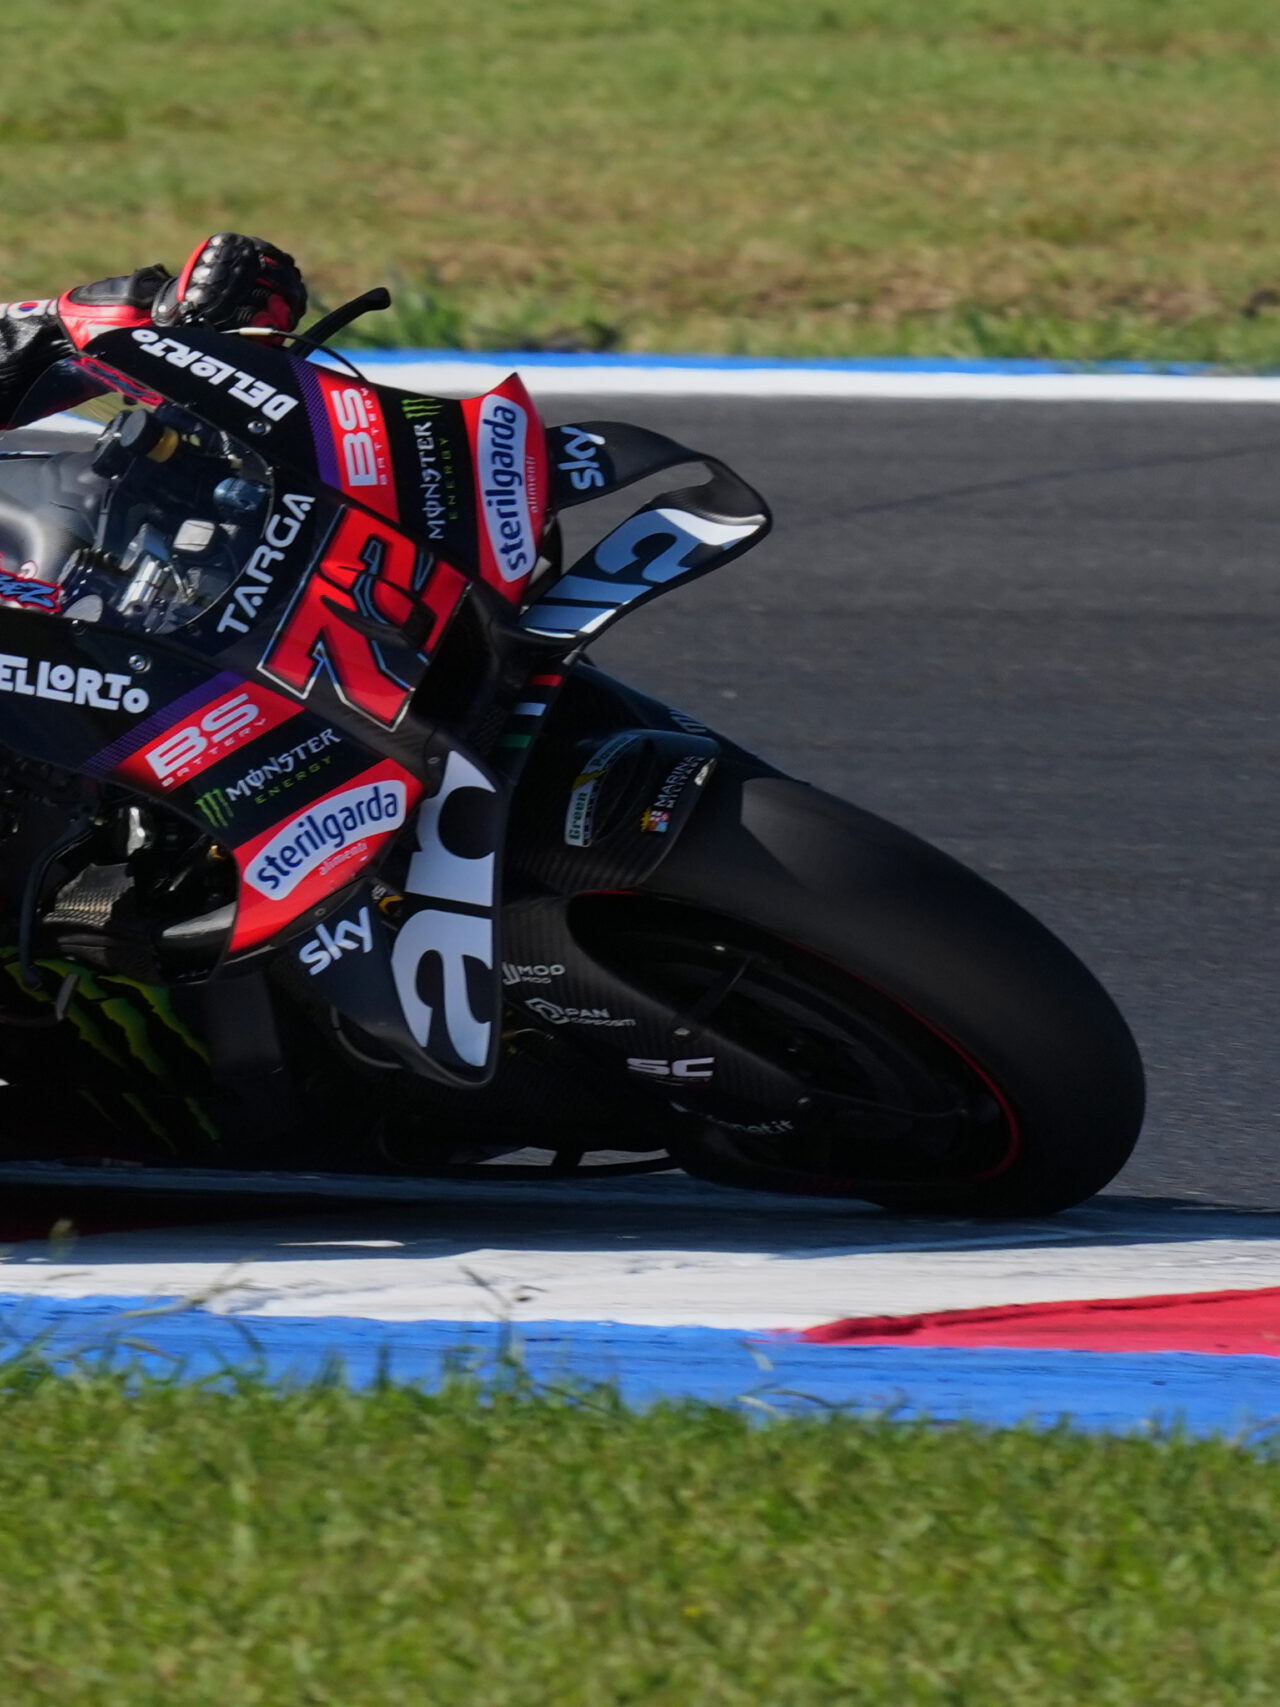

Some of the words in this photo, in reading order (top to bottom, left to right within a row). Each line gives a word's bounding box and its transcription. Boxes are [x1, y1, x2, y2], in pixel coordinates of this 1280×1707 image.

[131, 329, 298, 421] DELLORTO
[330, 388, 378, 487] BS
[413, 421, 446, 540] MONSTER
[439, 437, 458, 521] ENERGY
[558, 426, 606, 490] sky
[482, 405, 528, 572] sterilgarda
[217, 493, 316, 633] TARGA
[144, 692, 260, 780] BS
[224, 728, 341, 801] MONSTER
[254, 755, 332, 805] ENERGY
[257, 785, 398, 890] sterilgarda
[298, 907, 373, 976] sky
[626, 1056, 716, 1077] SC
